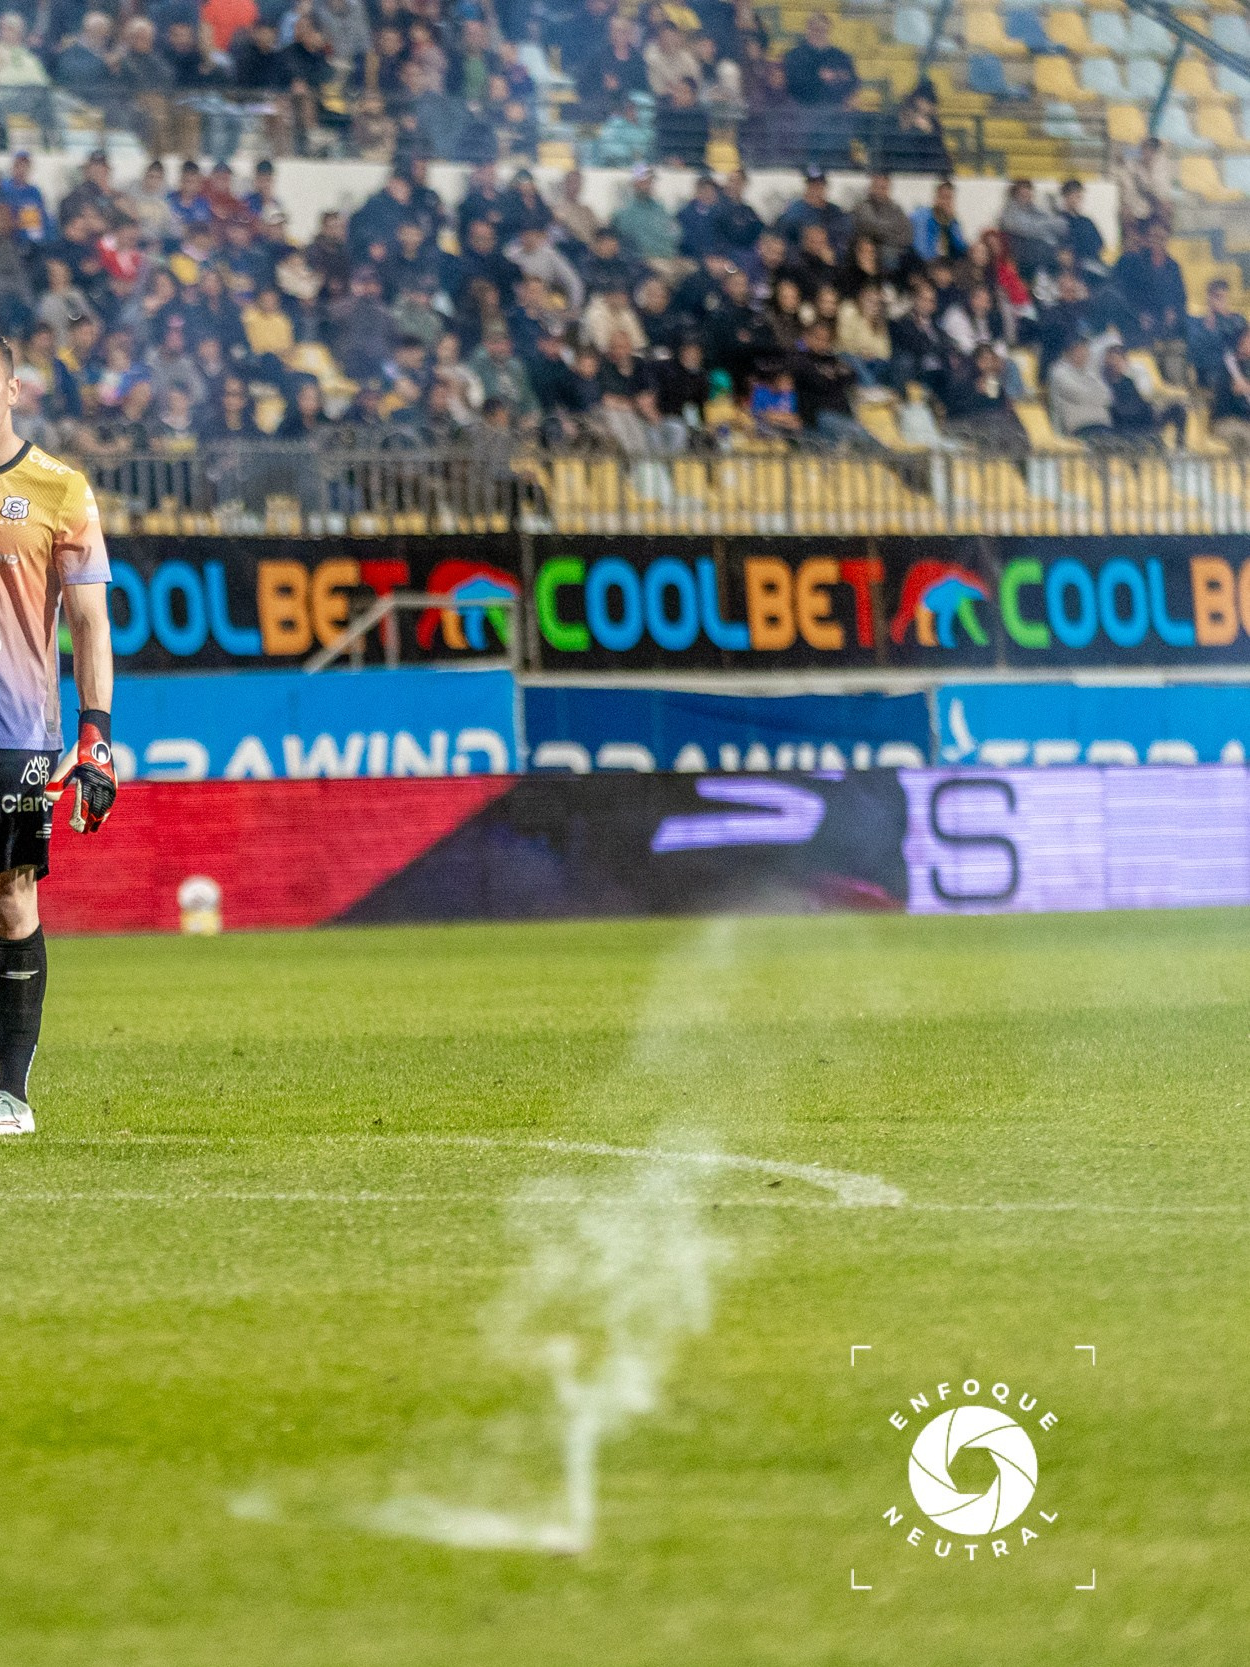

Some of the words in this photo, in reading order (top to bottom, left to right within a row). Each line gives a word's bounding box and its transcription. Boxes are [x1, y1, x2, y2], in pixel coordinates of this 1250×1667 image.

[60, 558, 410, 657] OOLBET
[536, 555, 884, 652] COOLBET
[1000, 555, 1250, 650] COOLB
